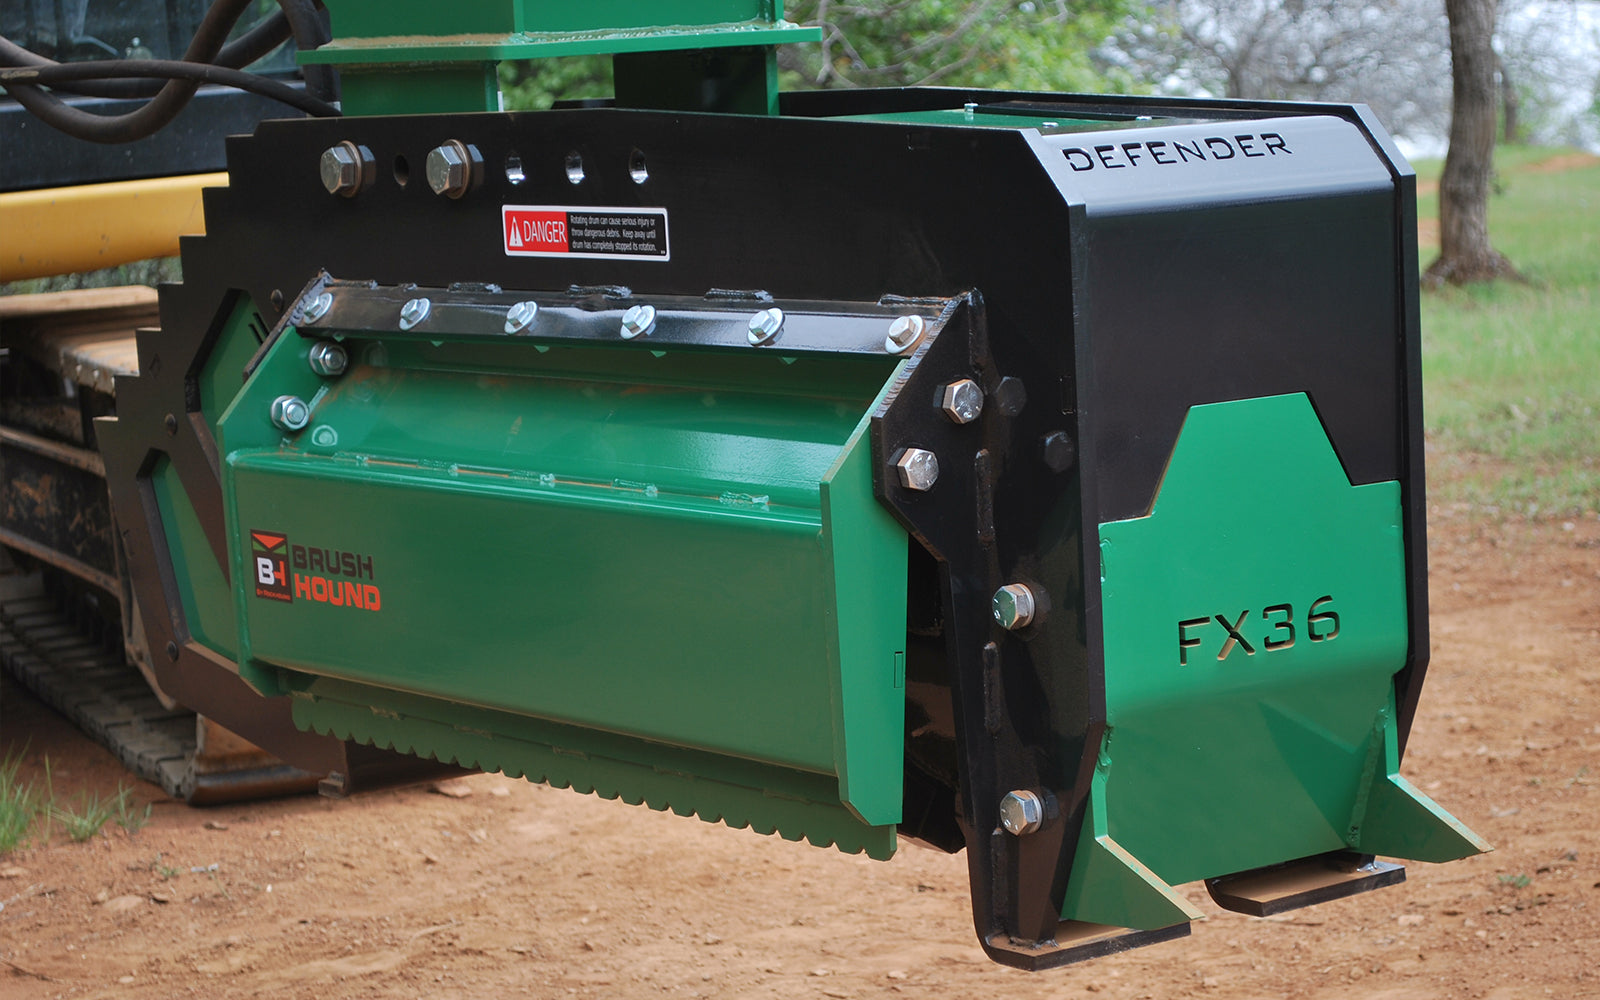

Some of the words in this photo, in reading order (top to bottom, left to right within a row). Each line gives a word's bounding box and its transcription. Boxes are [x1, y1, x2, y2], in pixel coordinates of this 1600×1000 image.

[1062, 133, 1293, 171] DEFENDER
[523, 220, 567, 243] DANGER
[570, 215, 587, 226] Rotating
[588, 216, 599, 225] drum
[600, 217, 608, 225] can
[608, 218, 620, 226] cause
[621, 217, 636, 226] serious
[637, 217, 649, 228] injury
[571, 228, 583, 236] throw
[584, 228, 605, 239] dangerous
[606, 229, 621, 238] debris.
[622, 229, 633, 239] Keep
[634, 231, 645, 240] away
[646, 229, 656, 239] until
[572, 240, 583, 249] drum
[592, 241, 614, 252] completely
[615, 242, 632, 252] stopped
[639, 243, 656, 251] rotation.
[292, 544, 374, 580] BRUSH
[294, 573, 381, 611] HOUND
[1178, 595, 1340, 666] FX36
